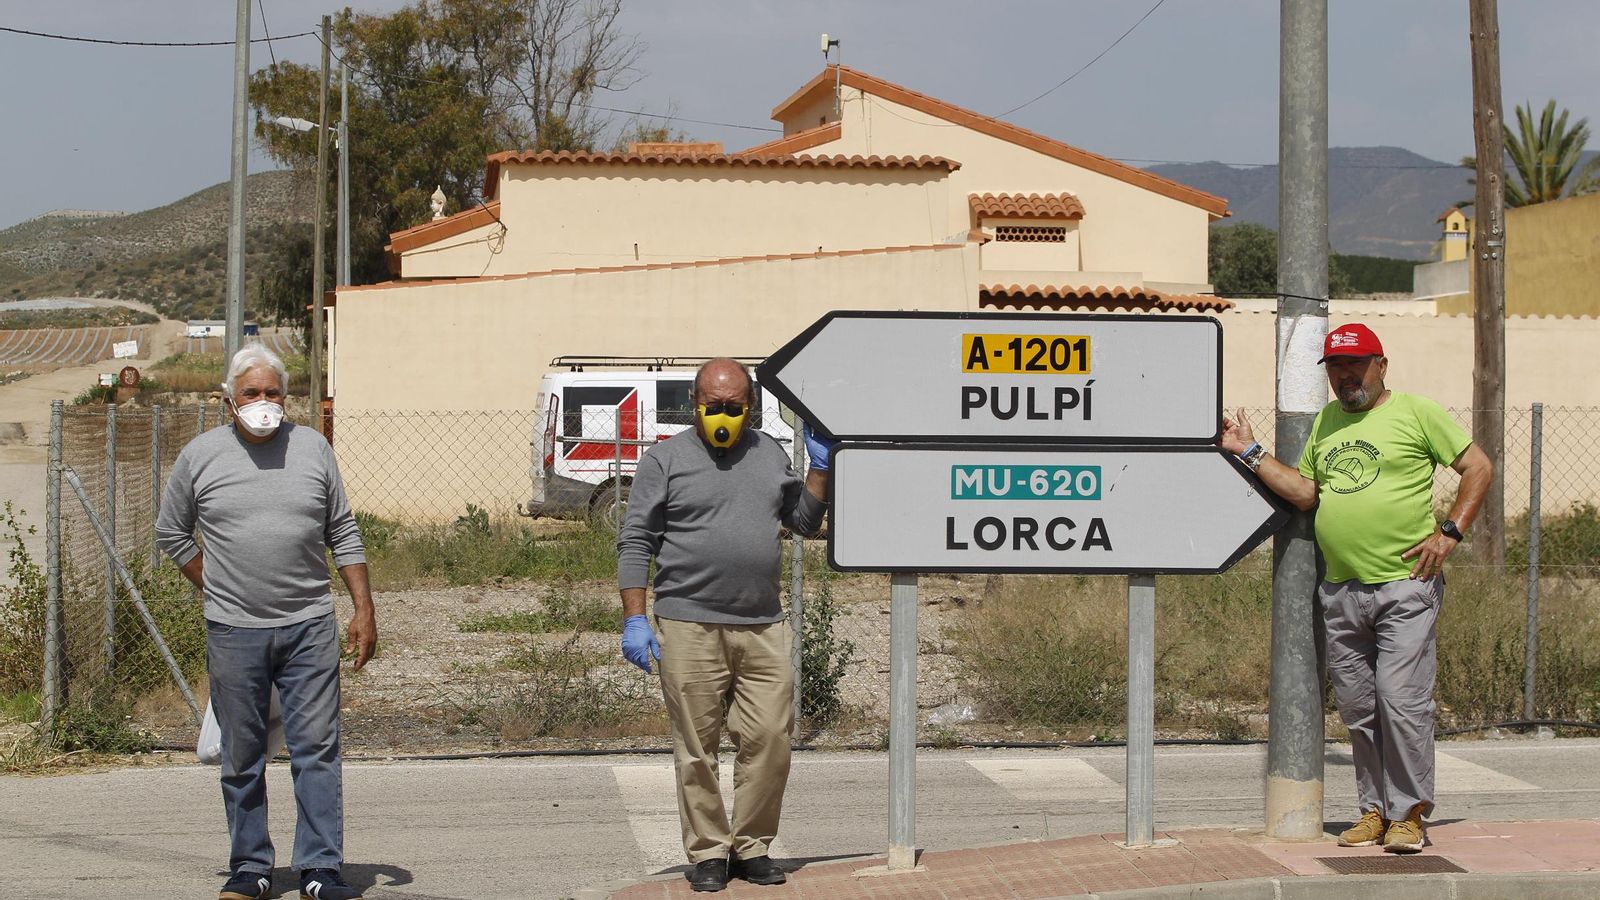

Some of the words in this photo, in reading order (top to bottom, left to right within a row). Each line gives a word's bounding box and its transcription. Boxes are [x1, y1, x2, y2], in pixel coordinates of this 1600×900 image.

[967, 337, 1087, 371] A-1201
[962, 380, 1095, 420] PULPÍ
[1354, 439, 1381, 456] Higuera
[955, 469, 1097, 497] MU-620
[947, 517, 1112, 551] LORCA
